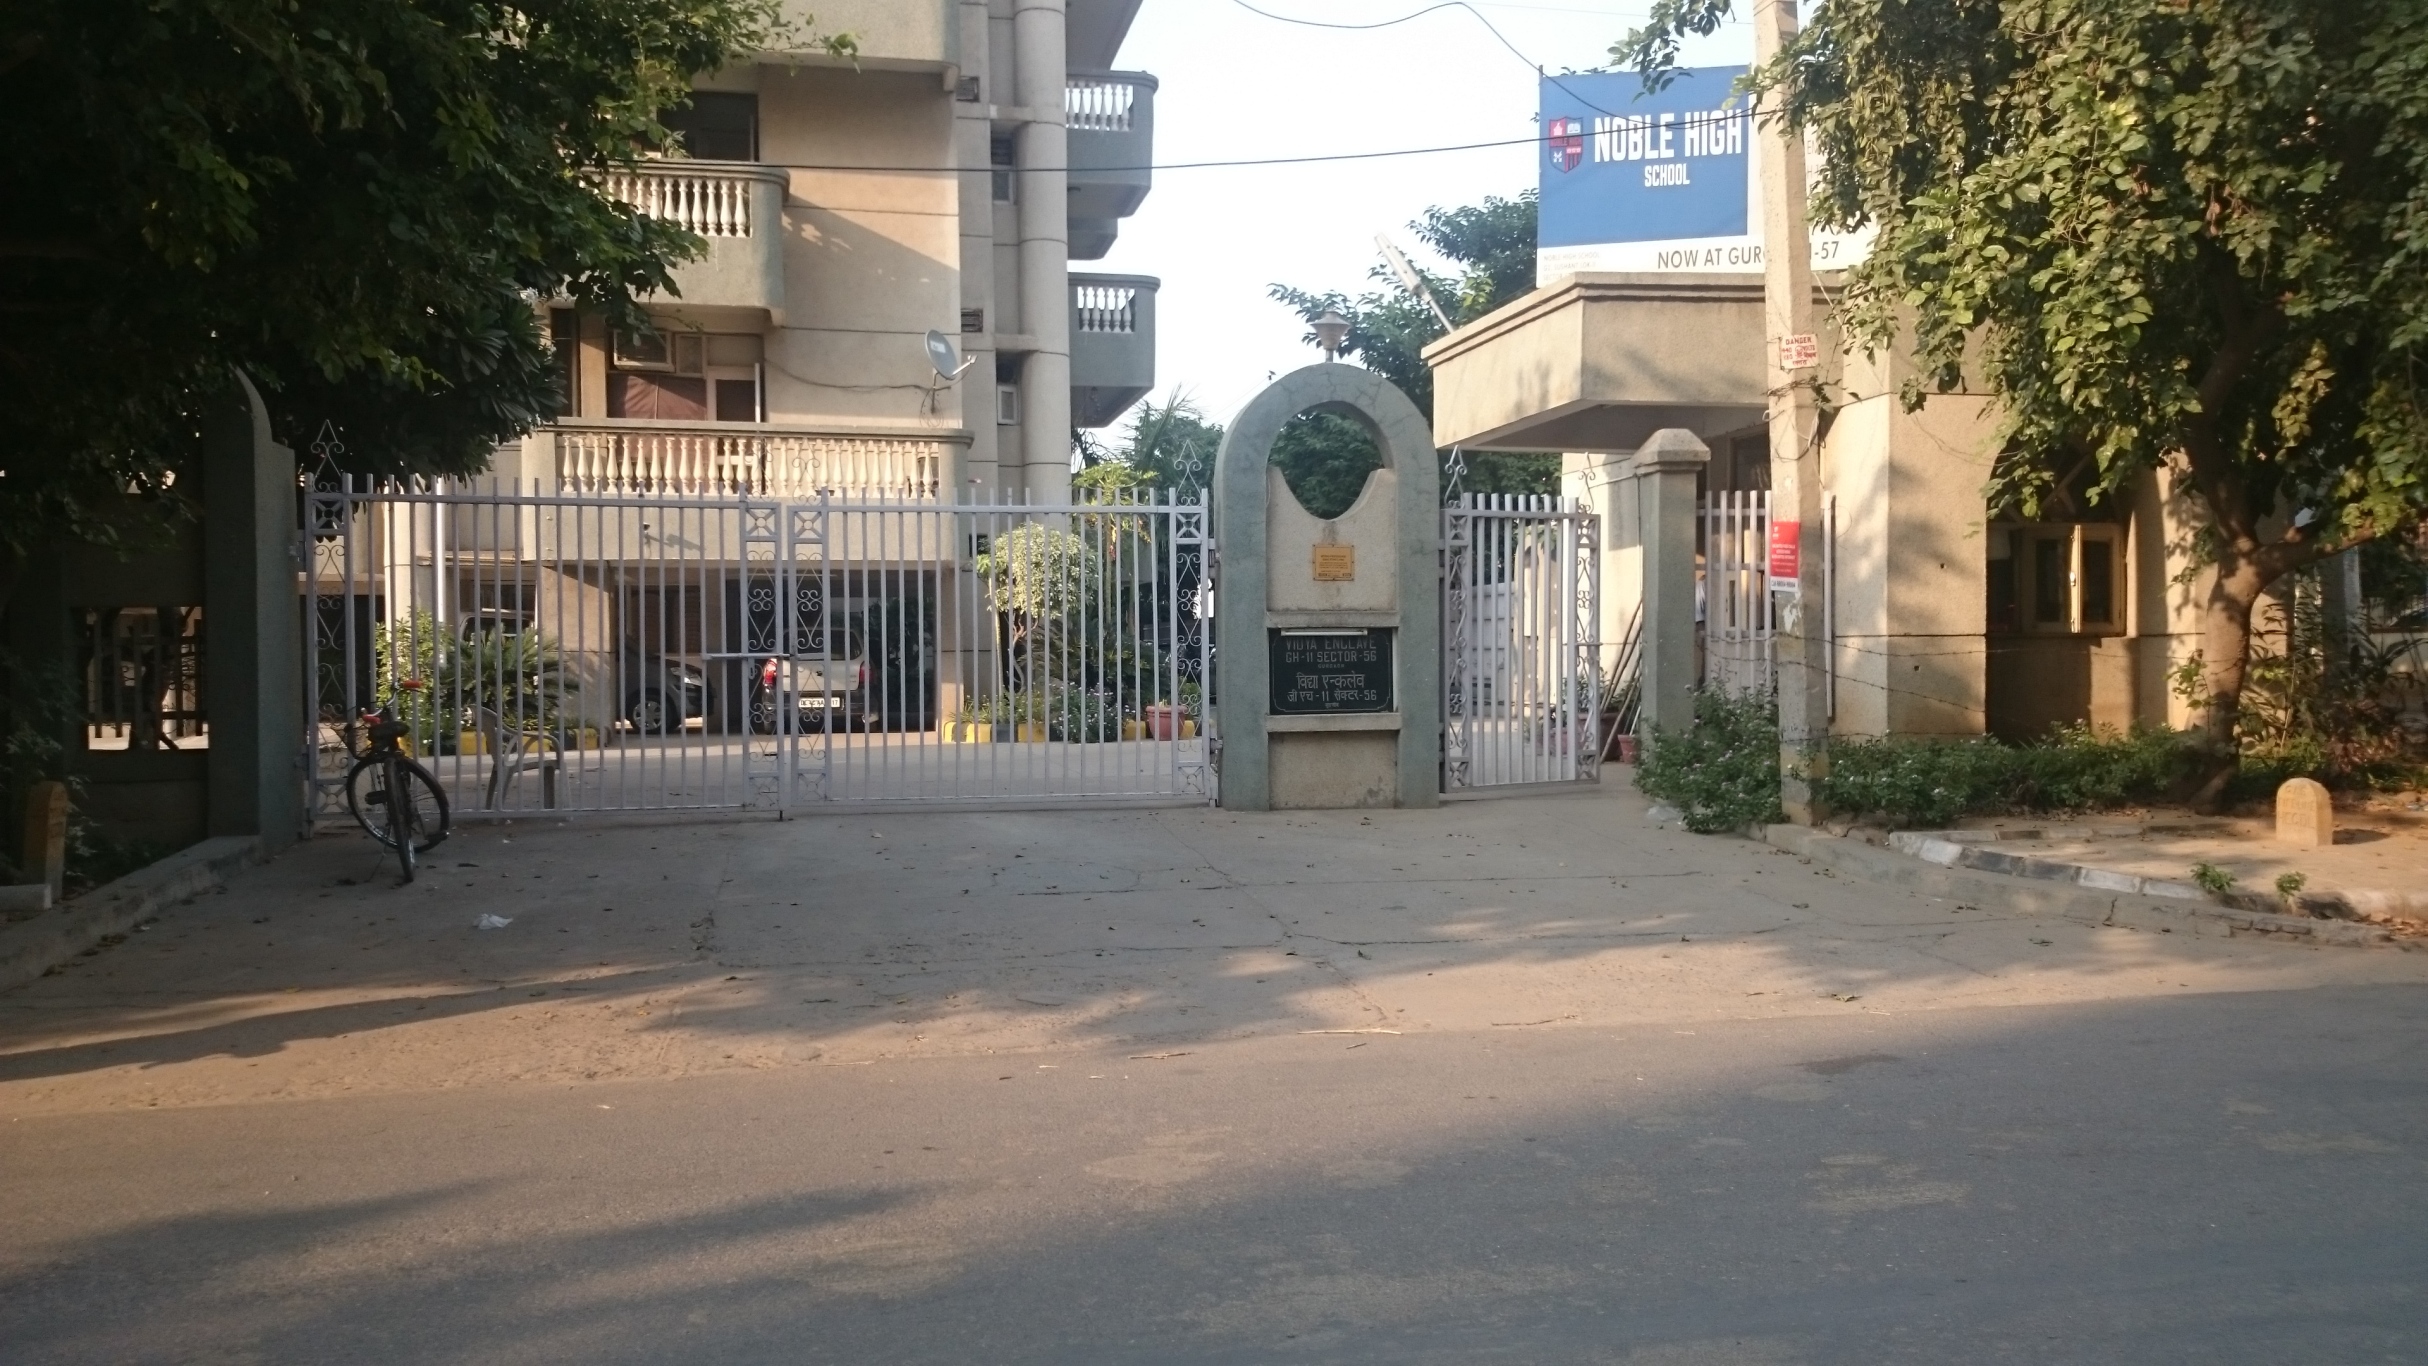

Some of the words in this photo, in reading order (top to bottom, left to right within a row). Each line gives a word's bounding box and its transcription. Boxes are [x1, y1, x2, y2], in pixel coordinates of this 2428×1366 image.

[1594, 112, 1675, 163] NOBLE
[1684, 108, 1742, 158] HIGH
[1644, 163, 1690, 187] SCHOOL
[1657, 250, 1698, 269] NOW
[1704, 248, 1722, 266] AT
[1785, 337, 1812, 345] DANGER
[1286, 637, 1317, 650] VIDYA
[1324, 635, 1376, 650] ENCLAVE
[1295, 672, 1318, 689] विद्या
